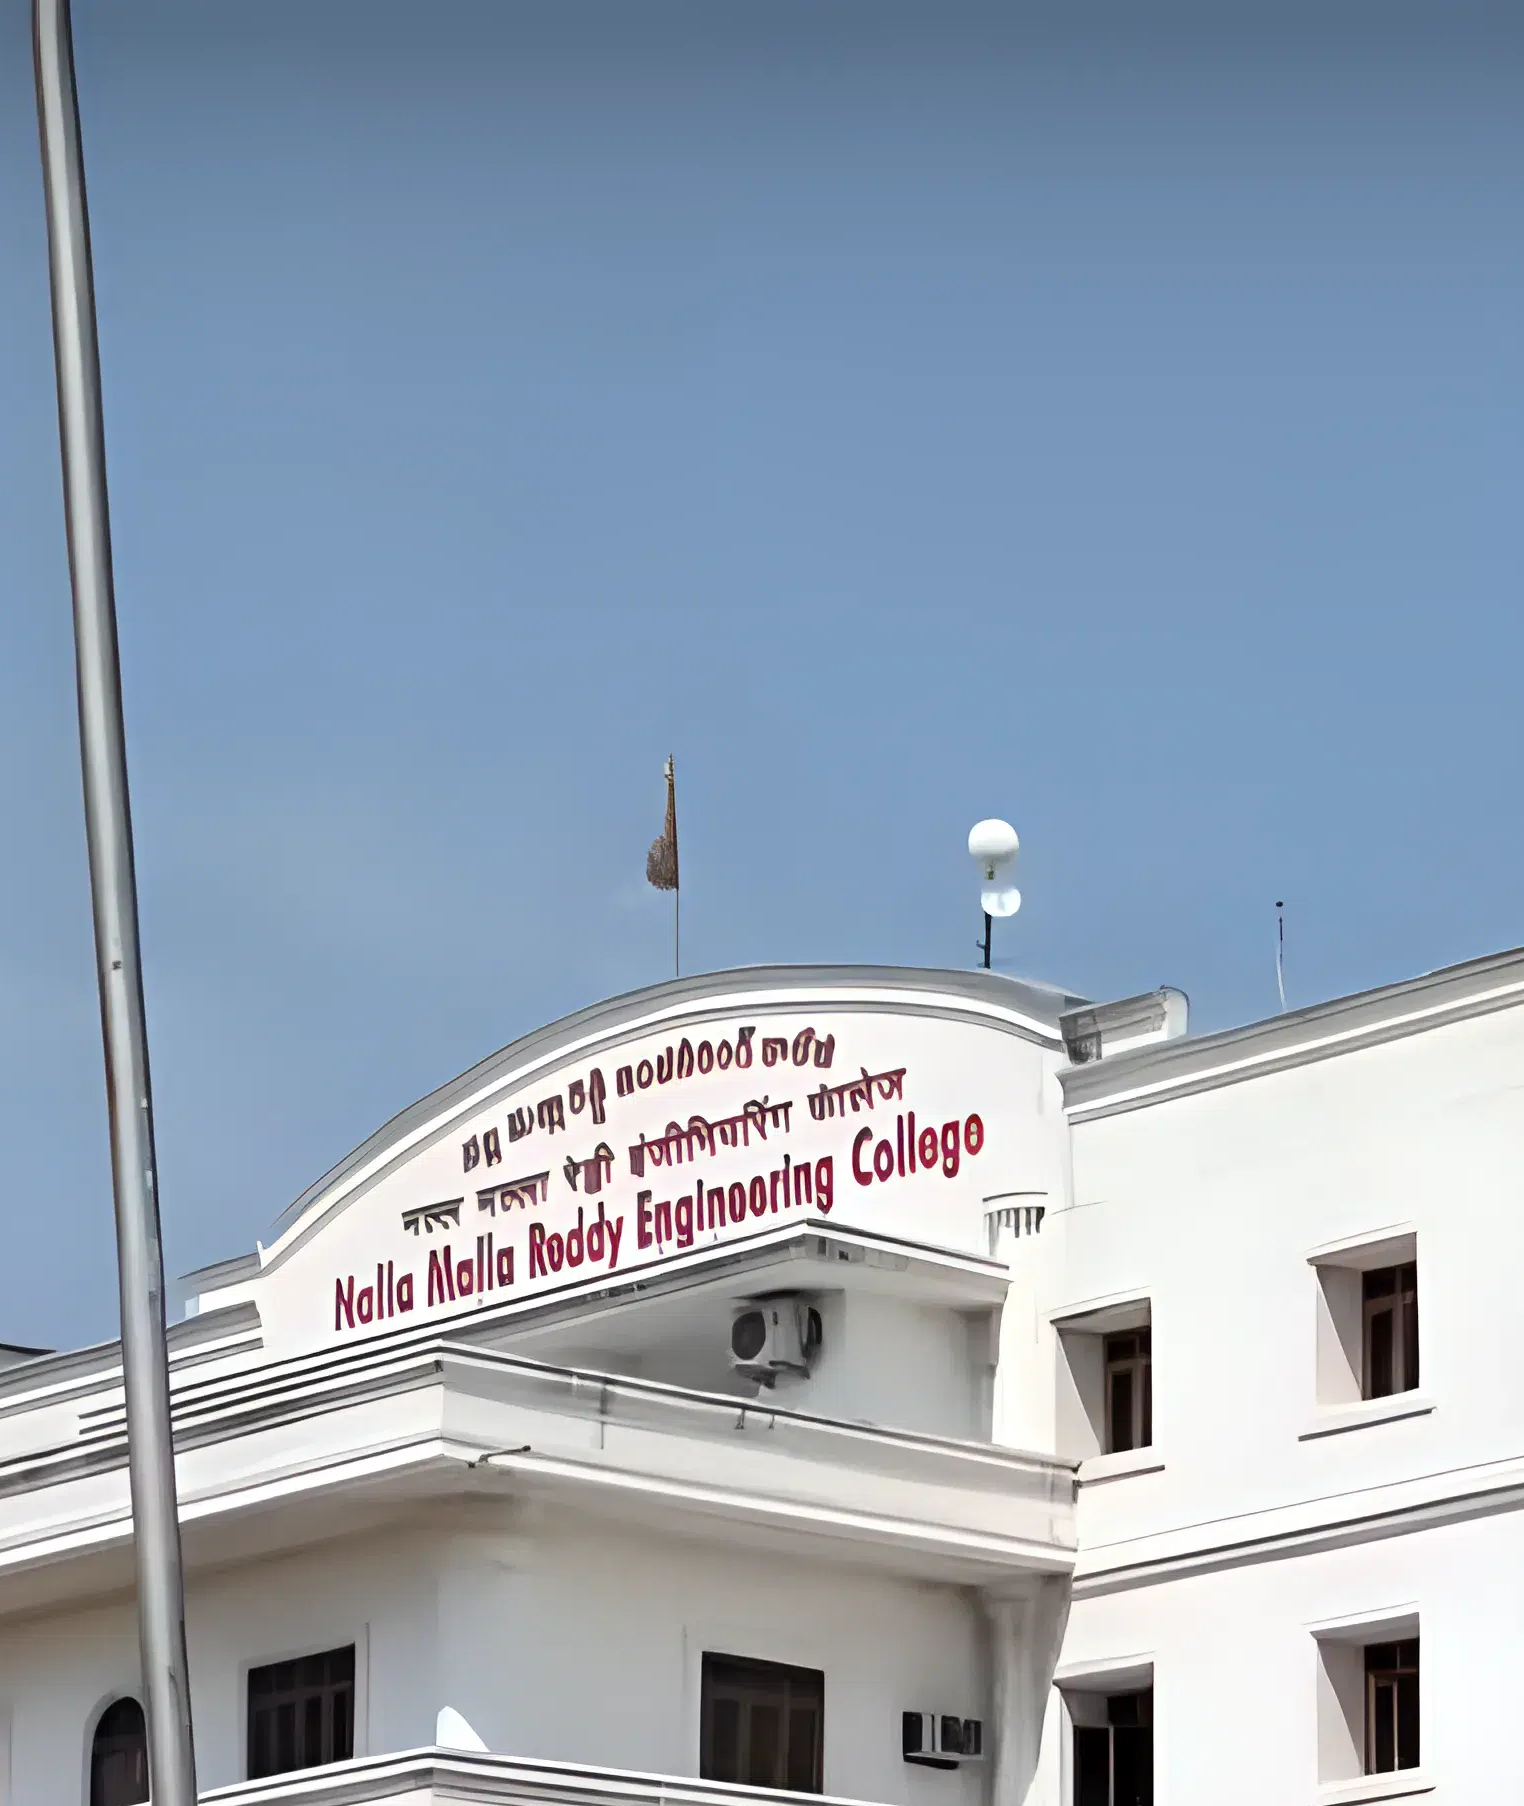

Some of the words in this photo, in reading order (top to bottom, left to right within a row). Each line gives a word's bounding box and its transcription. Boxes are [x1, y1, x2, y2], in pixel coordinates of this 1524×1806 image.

[334, 1259, 414, 1332] Nalla
[427, 1231, 515, 1308] Malla
[851, 1110, 985, 1187] College
